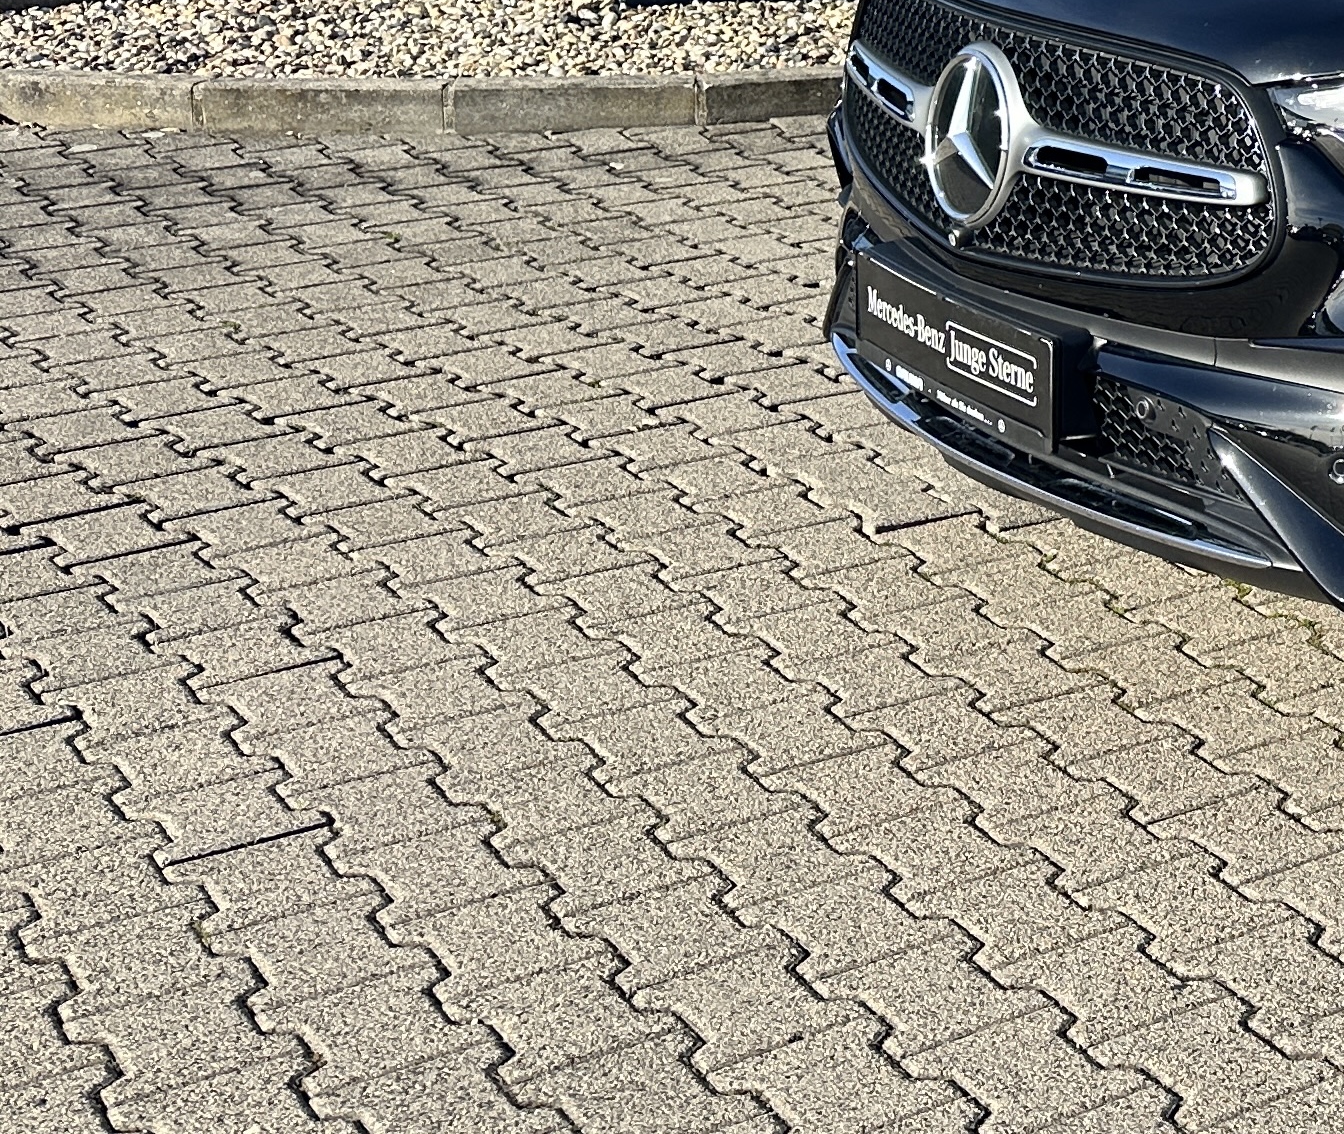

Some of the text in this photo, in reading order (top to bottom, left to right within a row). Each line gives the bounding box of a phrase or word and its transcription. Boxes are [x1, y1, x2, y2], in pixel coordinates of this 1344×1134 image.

[866, 285, 946, 354] Mercedes-Benz
[949, 329, 1034, 394] Junge Sterne
